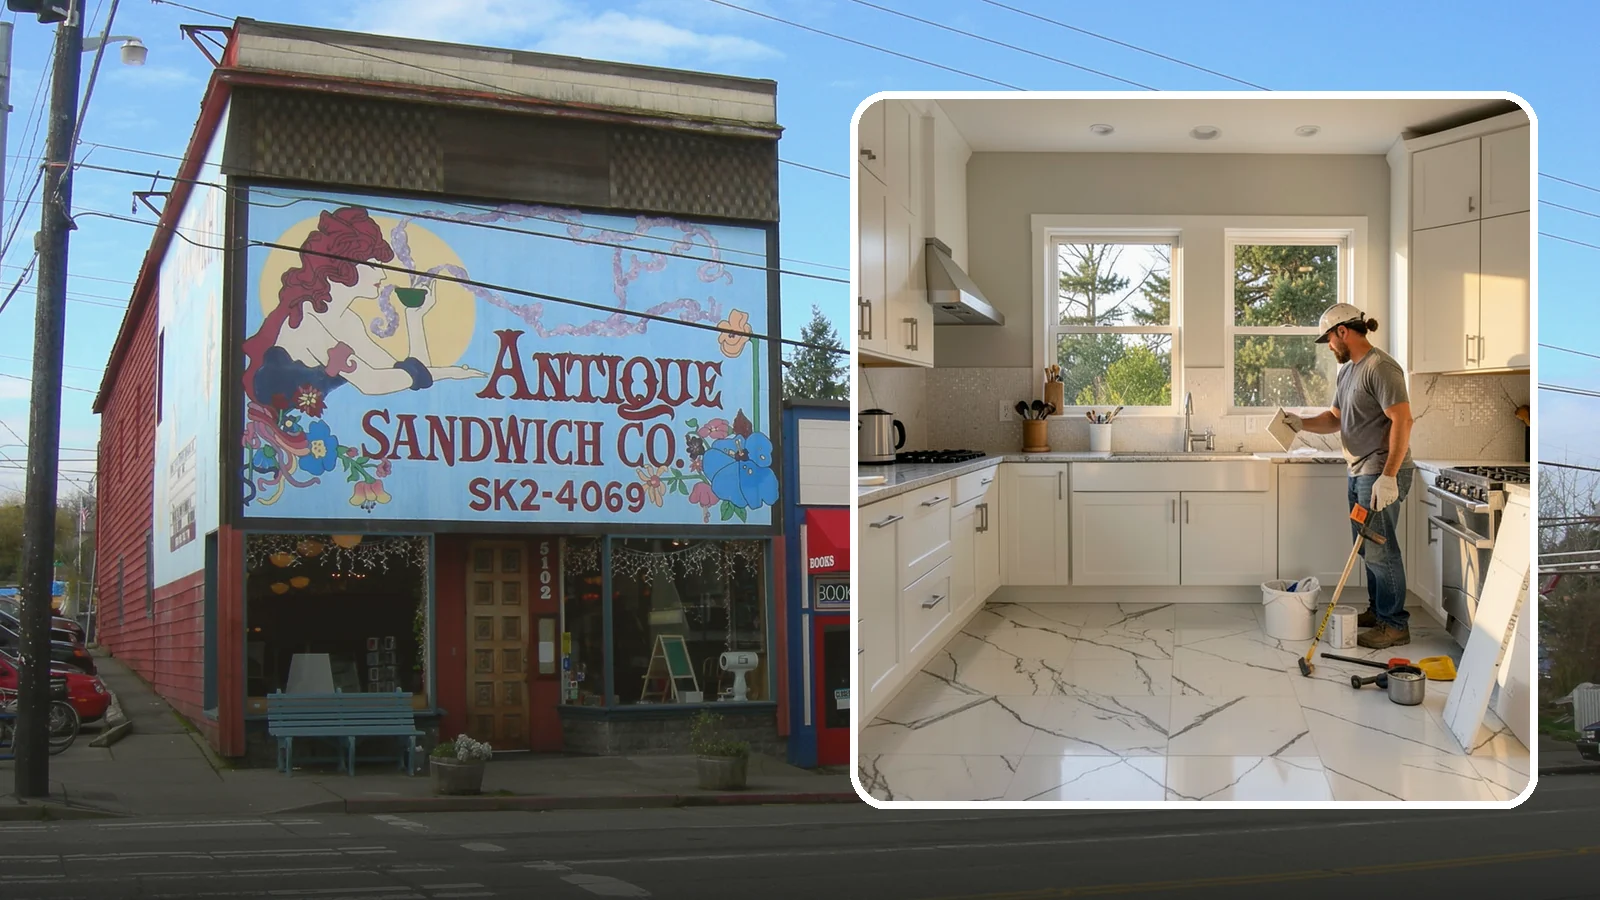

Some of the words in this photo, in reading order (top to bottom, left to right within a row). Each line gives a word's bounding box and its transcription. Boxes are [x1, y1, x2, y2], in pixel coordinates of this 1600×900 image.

[476, 329, 723, 420] ANTIQUE
[361, 408, 604, 467] SANDWICH
[617, 421, 685, 468] CO.
[468, 477, 645, 513] SK2-4069
[539, 541, 552, 600] 5102
[809, 555, 835, 569] BOOKS
